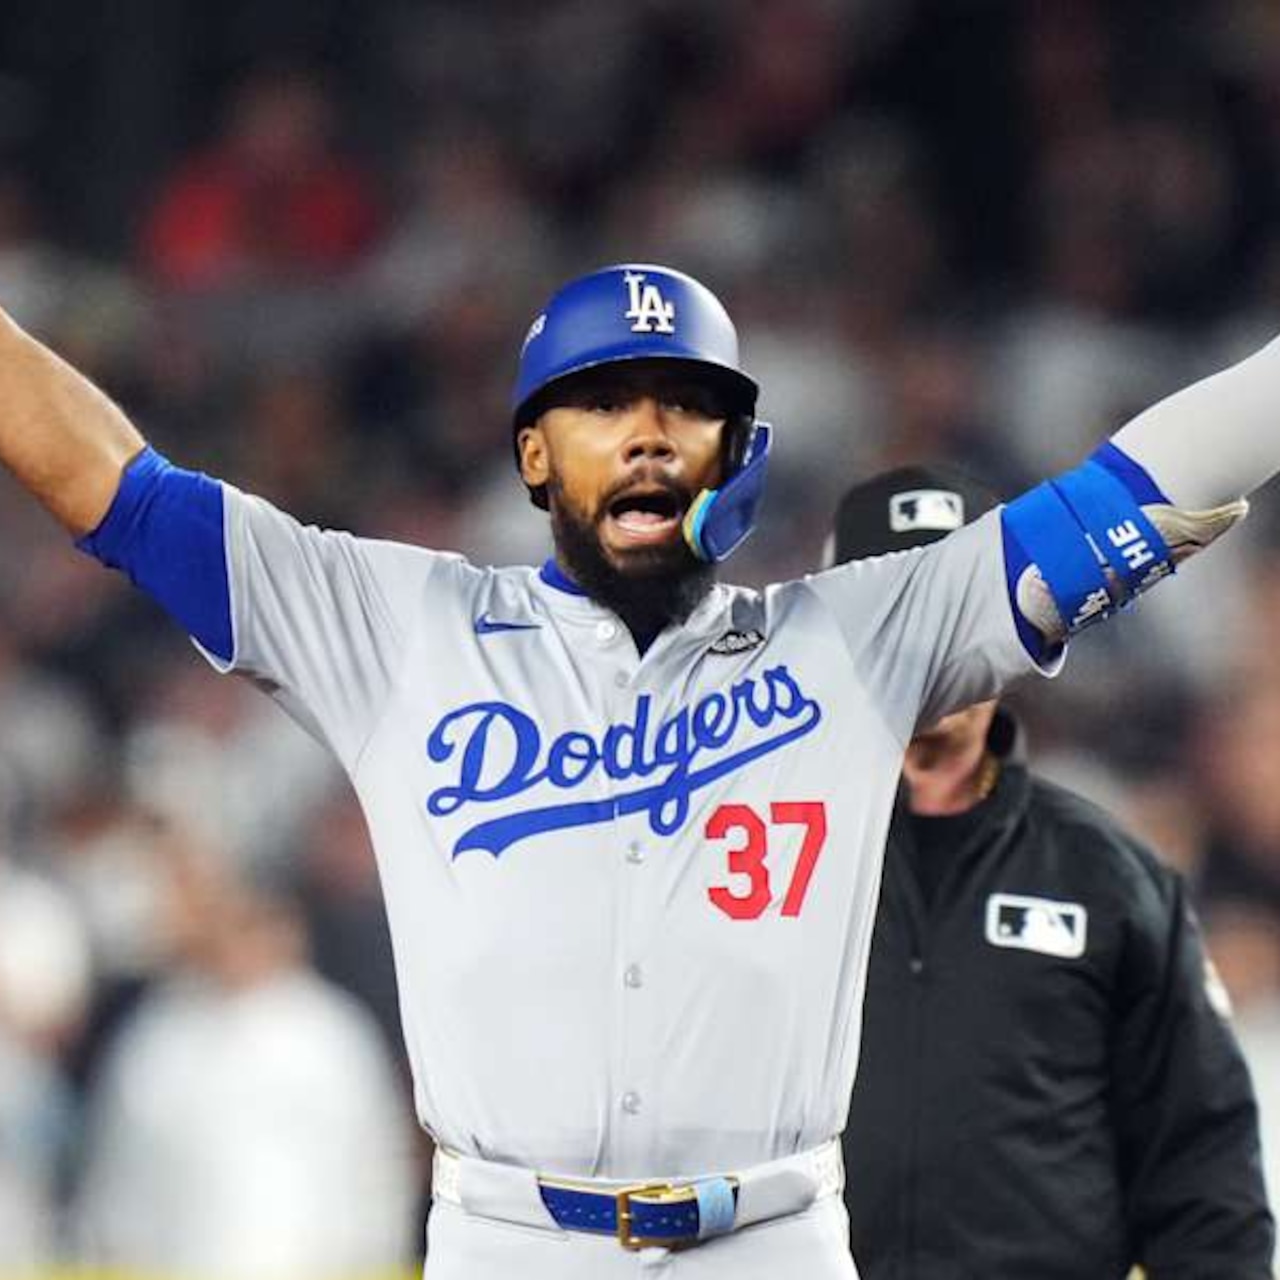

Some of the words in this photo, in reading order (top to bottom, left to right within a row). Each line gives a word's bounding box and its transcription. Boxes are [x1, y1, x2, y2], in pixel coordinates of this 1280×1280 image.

[623, 270, 676, 334] LA
[426, 664, 822, 840] Dodgers
[704, 801, 827, 920] 37
